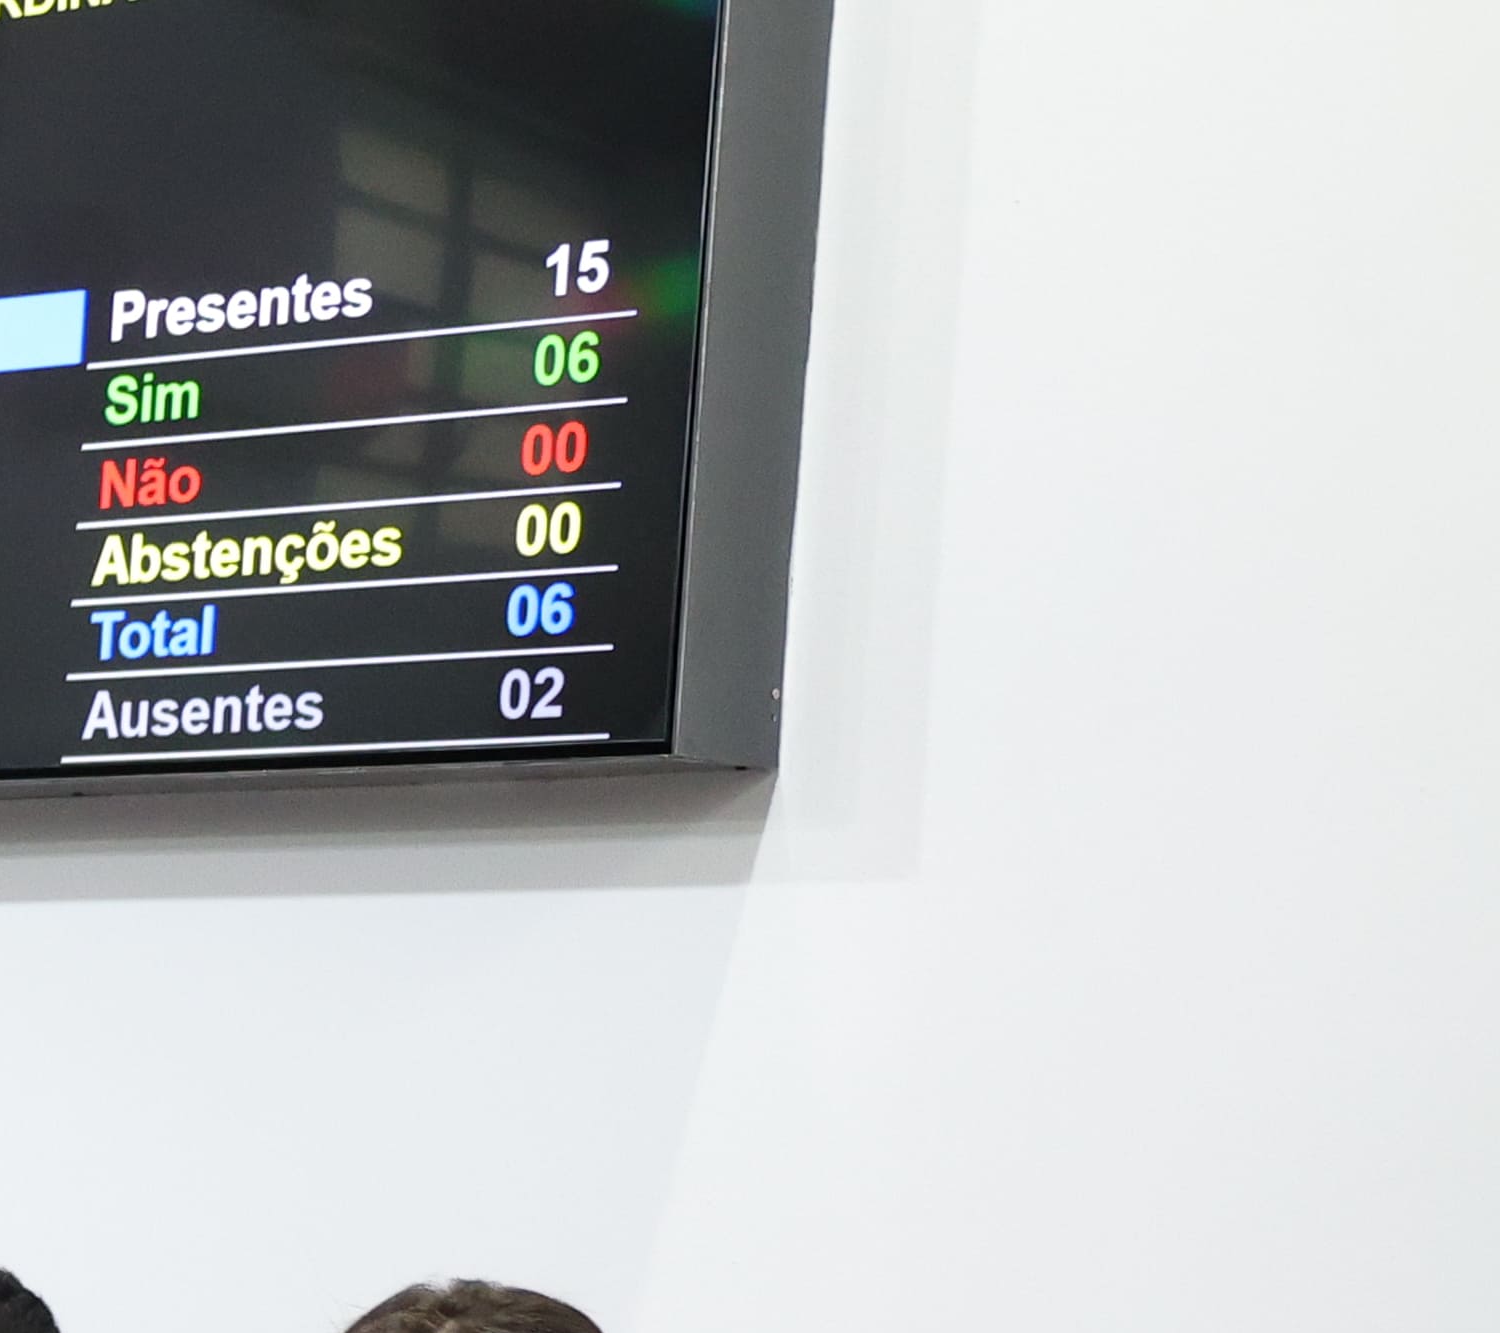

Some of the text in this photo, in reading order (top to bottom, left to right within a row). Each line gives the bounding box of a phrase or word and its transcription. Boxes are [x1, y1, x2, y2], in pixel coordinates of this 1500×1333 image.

[546, 240, 609, 296] 15
[111, 274, 372, 342] Presentes
[535, 331, 598, 385] 06
[105, 373, 199, 425] Sim
[521, 421, 587, 475] 00
[100, 458, 201, 509] Não
[92, 521, 401, 586] Abstenções
[516, 502, 581, 556] 00
[90, 604, 218, 660] Total
[507, 582, 575, 636] 06
[82, 685, 323, 740] Ausentes
[500, 667, 564, 719] 02
